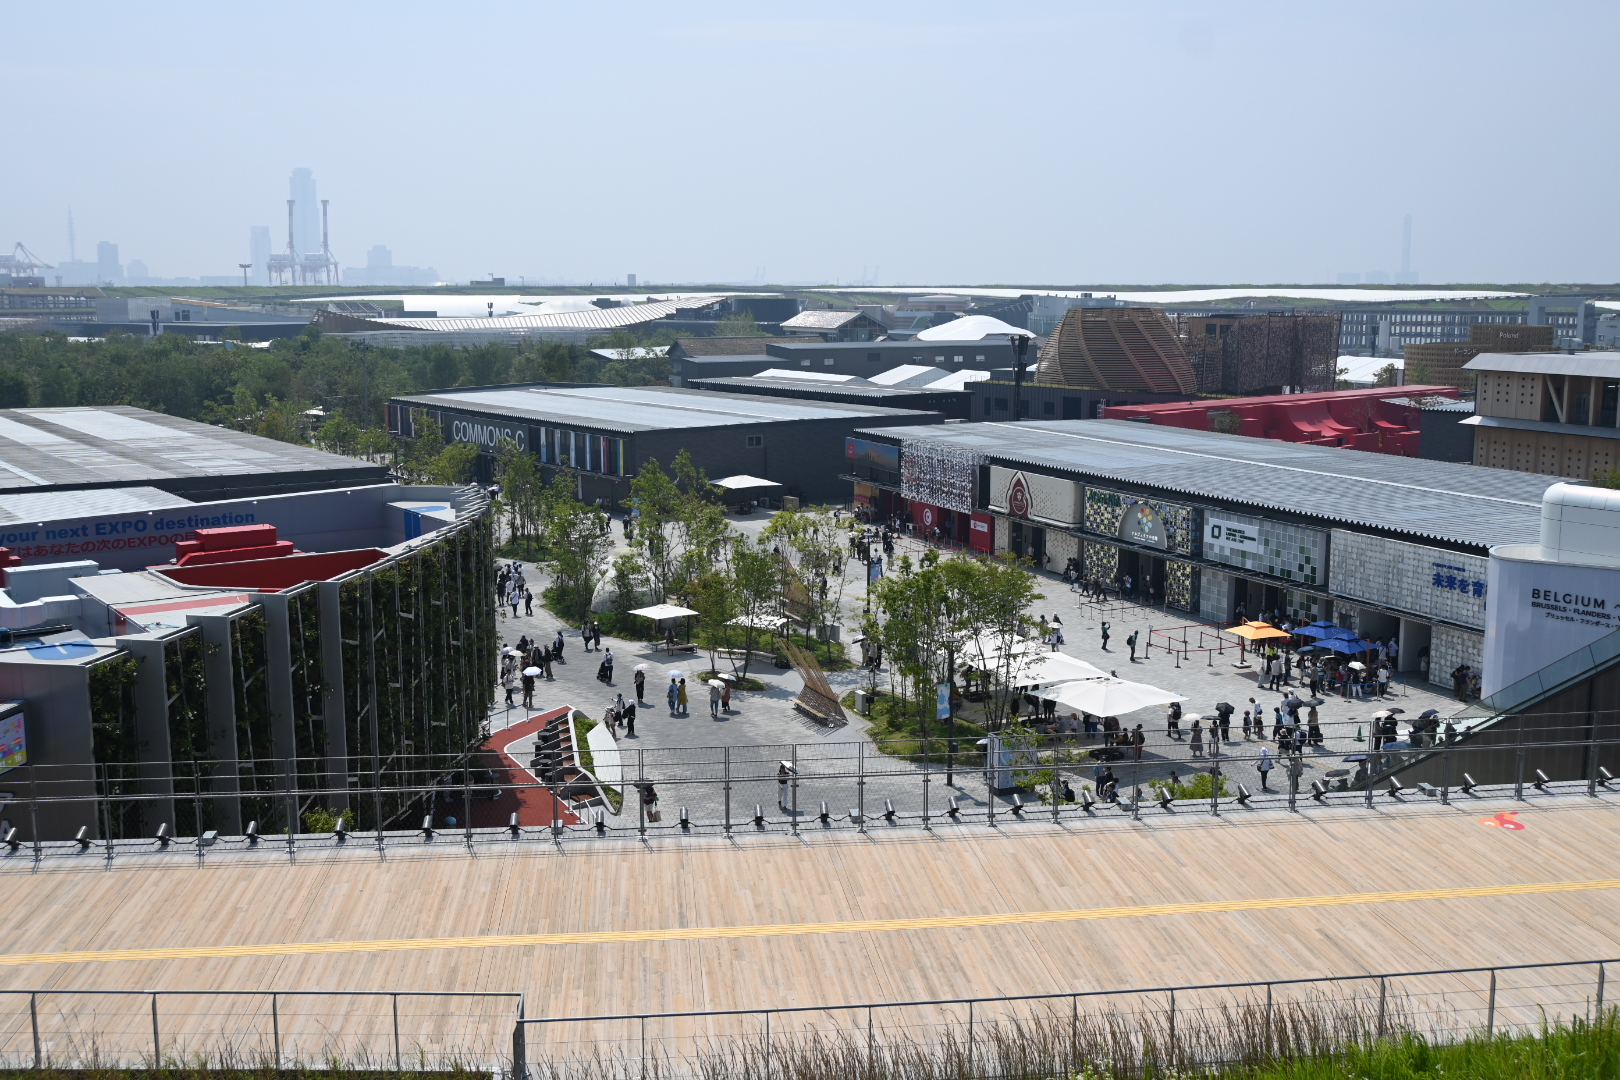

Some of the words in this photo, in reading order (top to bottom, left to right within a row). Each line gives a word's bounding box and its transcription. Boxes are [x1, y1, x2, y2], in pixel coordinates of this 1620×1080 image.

[453, 420, 512, 449] COMMONS
[515, 430, 525, 452] C
[46, 524, 89, 540] next
[95, 519, 147, 536] EXPO
[154, 512, 255, 531] destination
[1432, 572, 1488, 598] 未来を育
[1531, 588, 1605, 610] BELGIUM
[1531, 601, 1567, 612] BRUSSELS
[1573, 608, 1611, 620] FLANDERS
